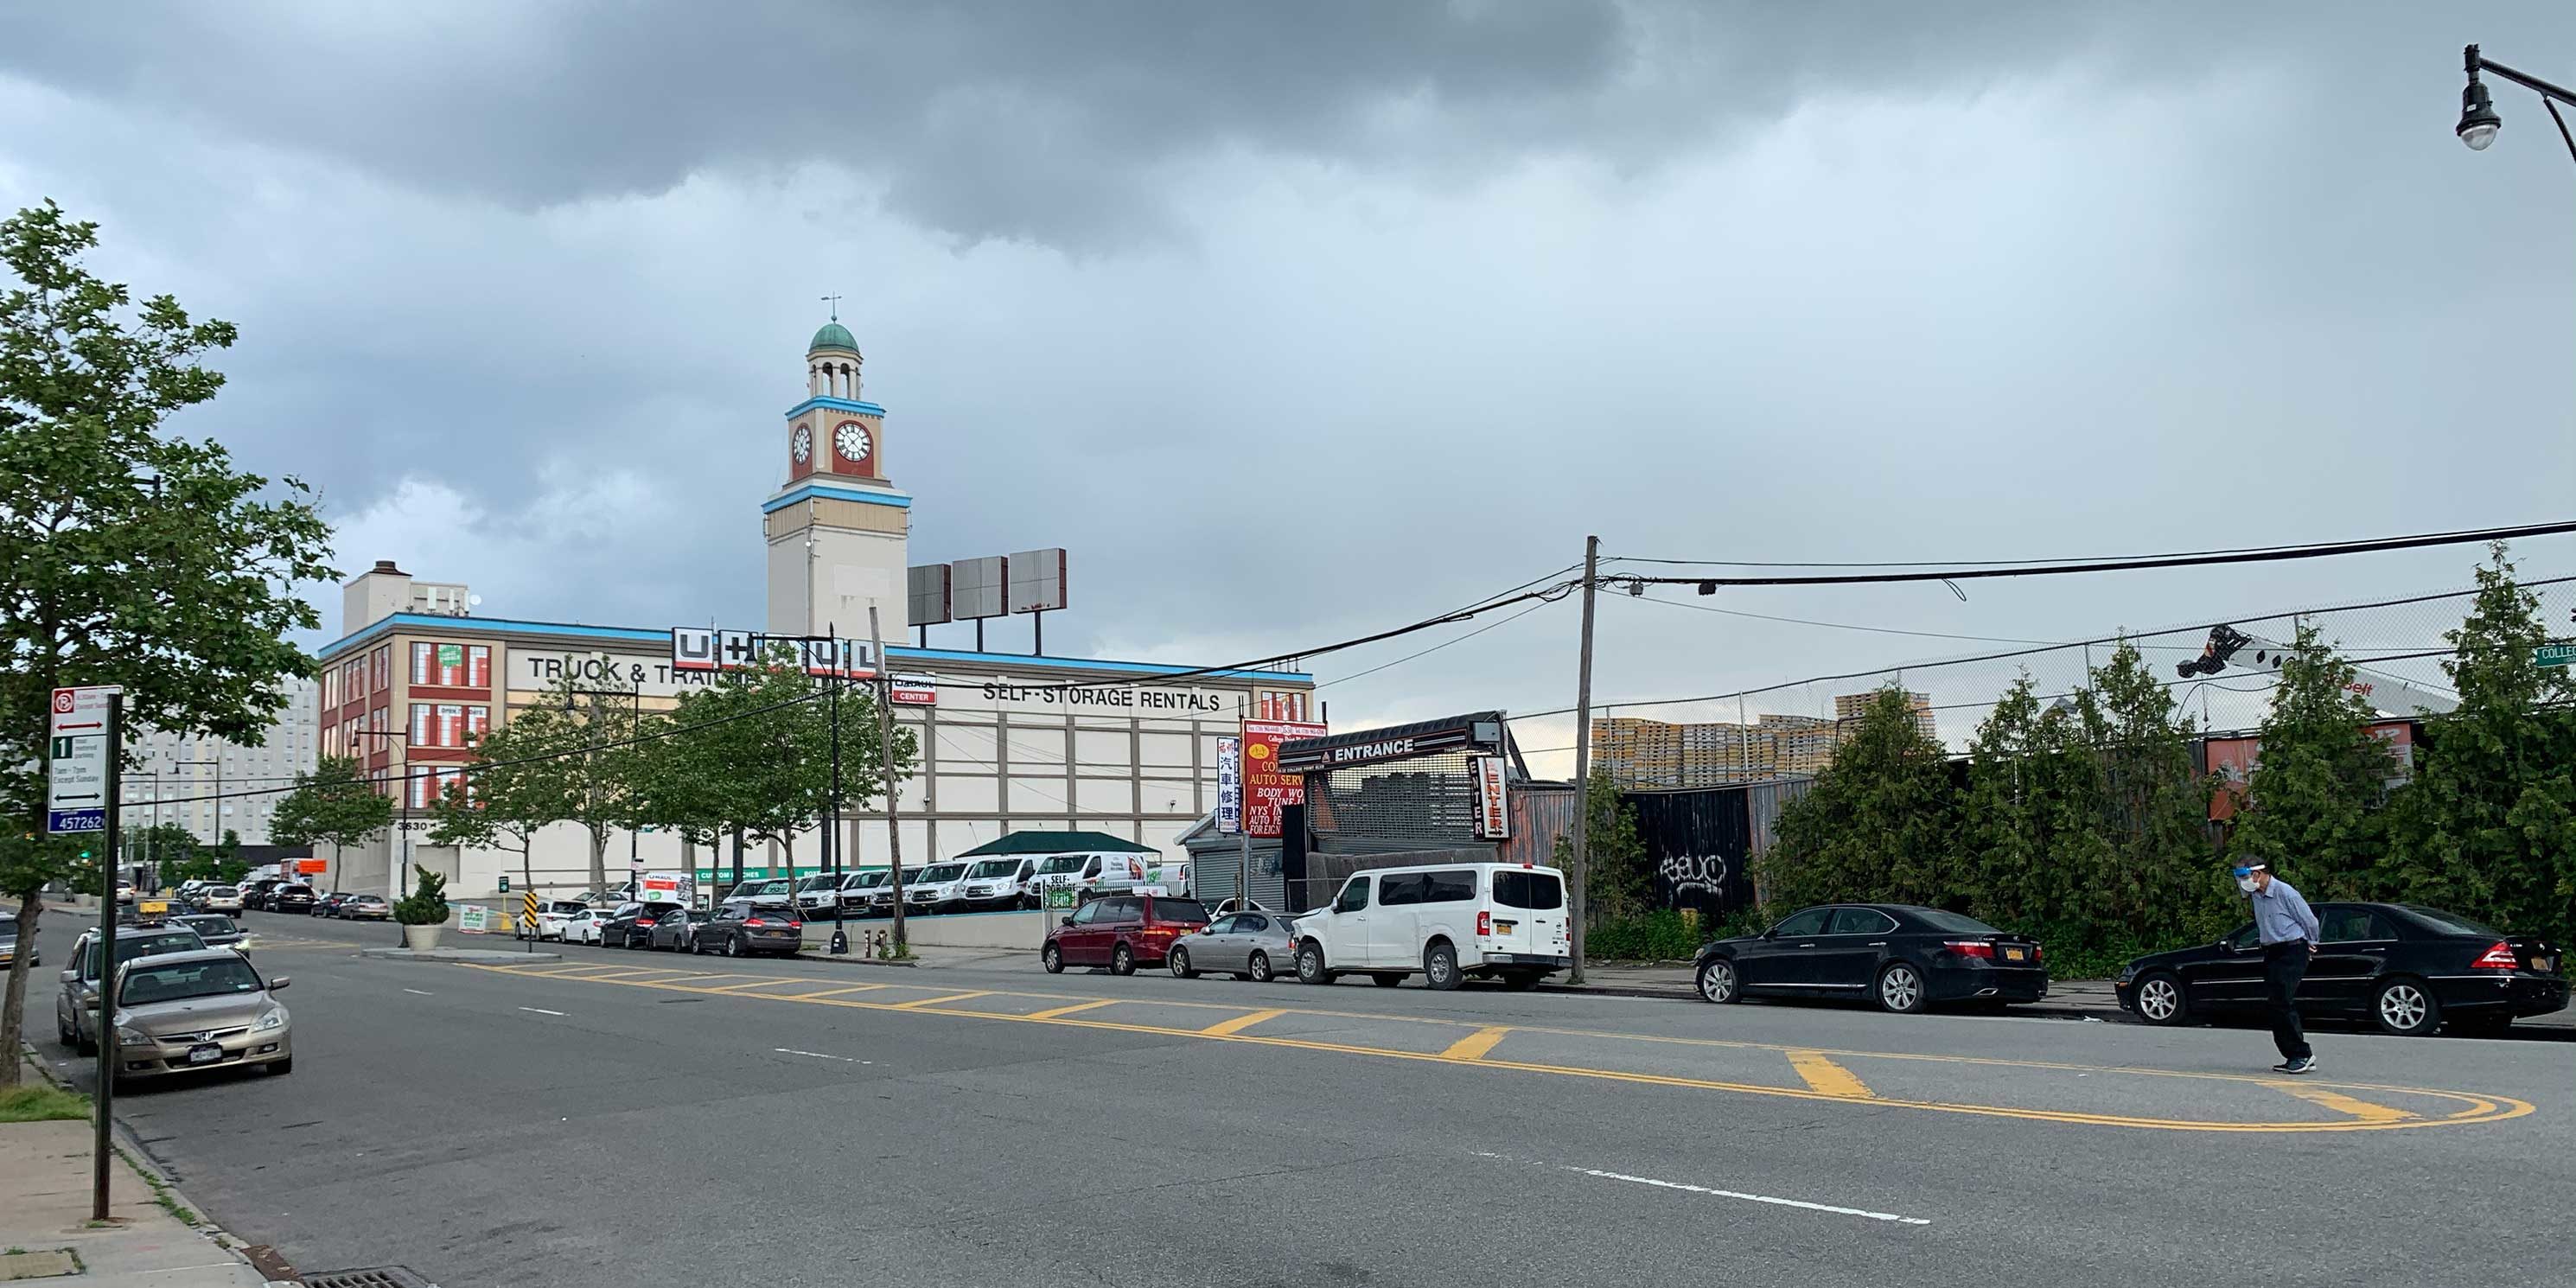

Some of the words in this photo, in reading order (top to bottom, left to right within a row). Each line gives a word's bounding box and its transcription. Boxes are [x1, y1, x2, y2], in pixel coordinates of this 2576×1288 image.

[528, 657, 622, 681] TRUCK
[630, 663, 646, 683] &
[900, 692, 929, 701] CENTER
[984, 683, 1132, 706] SELF-STORAGE
[1140, 692, 1220, 711] RENTALS
[59, 738, 66, 757] 1
[1335, 739, 1414, 761] ENTRANCE
[1250, 775, 1277, 785] AUTO
[1220, 756, 1234, 820] 汽車修理
[1257, 787, 1283, 798] BODY
[1469, 762, 1482, 835] ENTER
[1487, 774, 1502, 829] ENTER
[1249, 806, 1268, 815] NYS
[59, 816, 105, 830] 457262
[1249, 815, 1270, 825] AUTO
[398, 822, 427, 831] 3630
[1250, 825, 1281, 835] FOREIGN
[1051, 875, 1070, 883] SELF-
